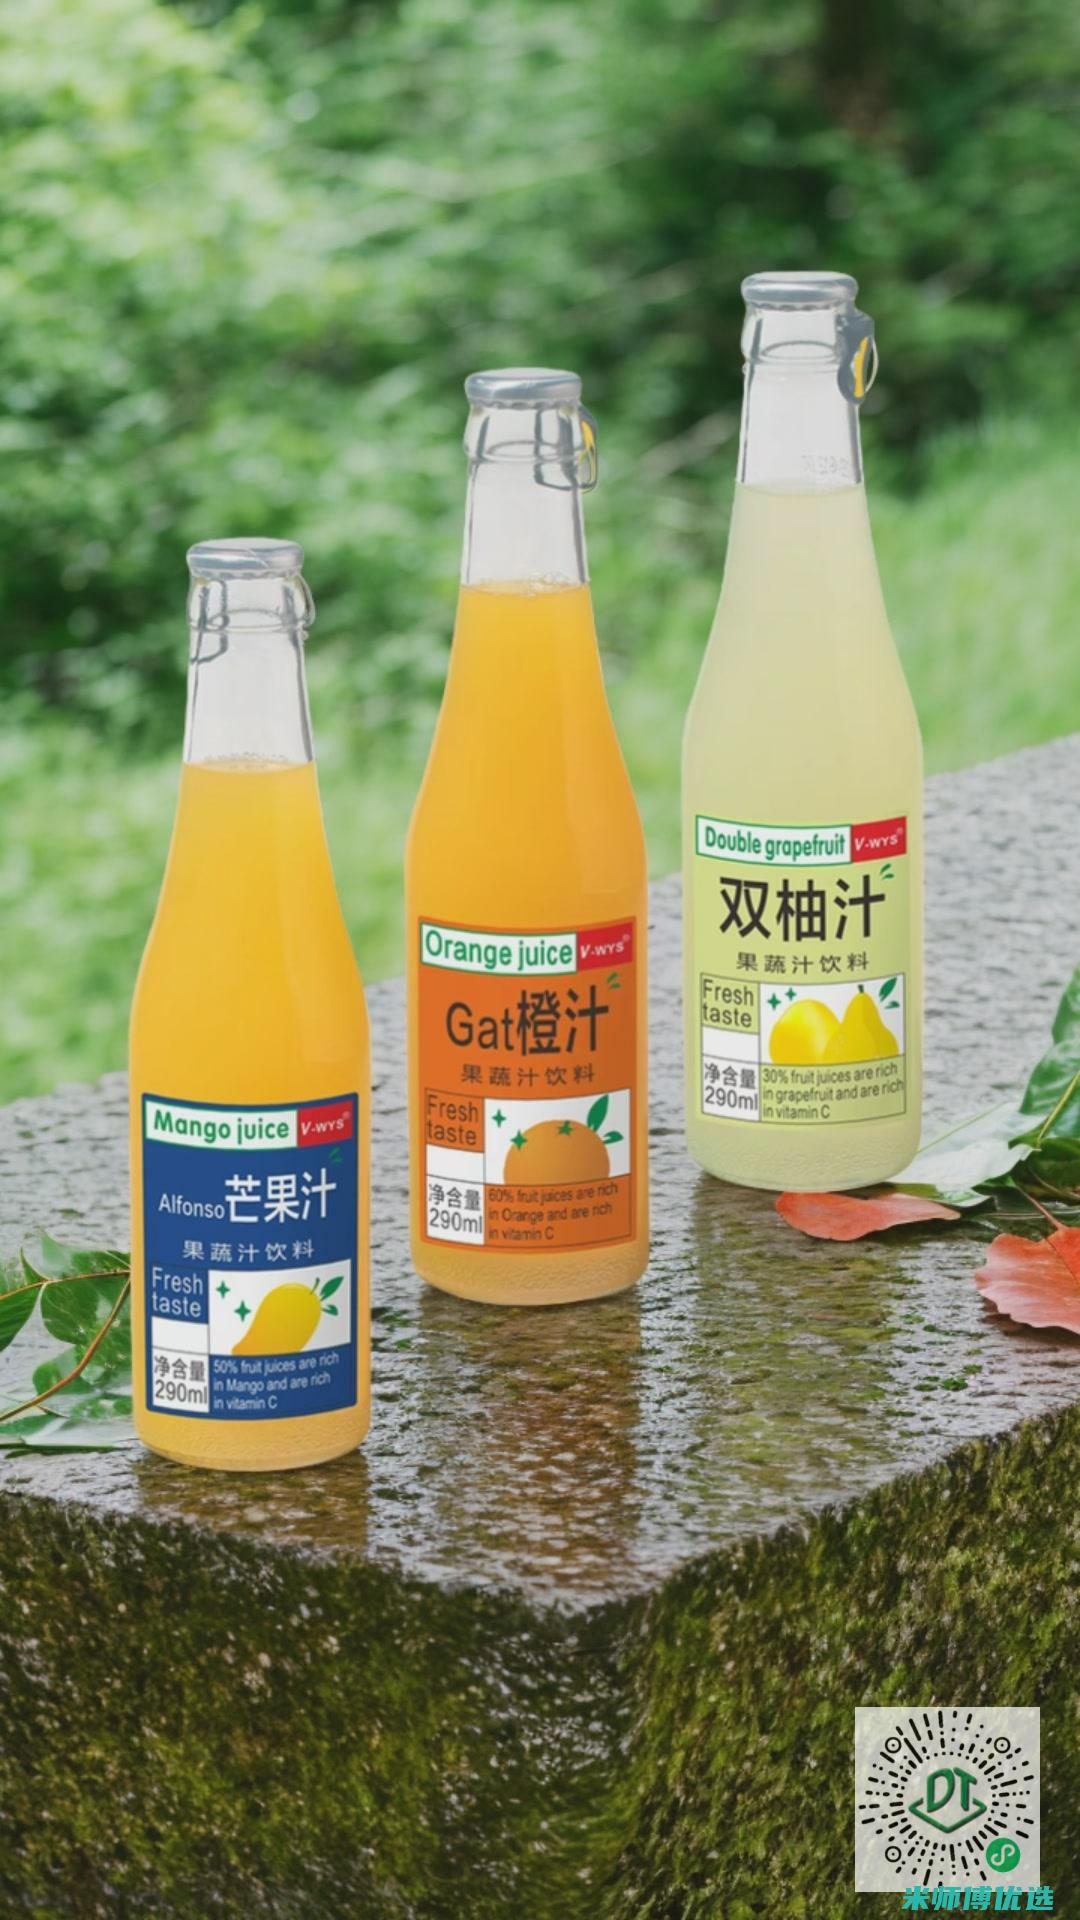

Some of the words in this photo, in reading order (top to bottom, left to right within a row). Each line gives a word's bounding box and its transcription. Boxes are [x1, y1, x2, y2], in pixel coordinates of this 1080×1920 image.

[705, 826, 761, 854] Double
[765, 833, 846, 862] grapefruit
[719, 874, 886, 942] 双柚汁
[425, 930, 512, 968] Orange
[517, 940, 572, 971] juice
[736, 951, 869, 975] 果蔬汁饮料
[703, 978, 754, 1007] Fresh
[702, 1003, 752, 1028] taste
[461, 1063, 596, 1087] 果蔬汁饮料
[705, 1063, 756, 1090] 净含量
[762, 1069, 789, 1084] 30%
[790, 1070, 814, 1084] fruit
[816, 1068, 851, 1086] juices
[853, 1067, 873, 1080] are
[875, 1063, 898, 1077] rich
[705, 1086, 758, 1111] 290ml
[763, 1088, 774, 1100] in
[776, 1087, 834, 1104] grapefruit
[836, 1083, 858, 1100] and
[859, 1084, 880, 1098] are
[882, 1079, 904, 1094] rich
[426, 1095, 478, 1123] Fresh
[763, 1106, 774, 1118] in
[776, 1105, 818, 1119] vitamin
[820, 1104, 830, 1118] C
[154, 1110, 231, 1144] Mango
[237, 1118, 289, 1145] juice
[426, 1119, 477, 1145] taste
[429, 1183, 481, 1211] 净含量
[488, 1188, 514, 1202] 60%
[517, 1188, 539, 1203] fruit
[540, 1188, 573, 1205] juices
[576, 1186, 595, 1199] are
[597, 1182, 618, 1196] rich
[430, 1208, 482, 1233] 290ml
[489, 1209, 498, 1220] in
[502, 1208, 544, 1225] Orange
[547, 1207, 568, 1221] and
[571, 1206, 589, 1218] are
[592, 1202, 613, 1215] rich
[489, 1227, 498, 1239] in
[501, 1227, 542, 1240] vitamin
[545, 1226, 554, 1240] C
[182, 1239, 315, 1263] 果蔬汁饮料
[152, 1267, 203, 1295] Fresh
[152, 1292, 201, 1317] taste
[154, 1356, 206, 1382] 净含量
[213, 1360, 238, 1374] 50%
[241, 1359, 262, 1373] fruit
[264, 1358, 296, 1376] juices
[299, 1357, 318, 1370] are
[319, 1352, 339, 1366] rich
[155, 1380, 207, 1404] 290ml
[213, 1381, 223, 1392] in
[226, 1379, 264, 1395] Mango
[267, 1377, 287, 1391] and
[290, 1376, 307, 1388] are
[310, 1372, 330, 1385] rich
[214, 1397, 223, 1409] in
[226, 1397, 265, 1409] vitamin
[268, 1396, 278, 1408] C
